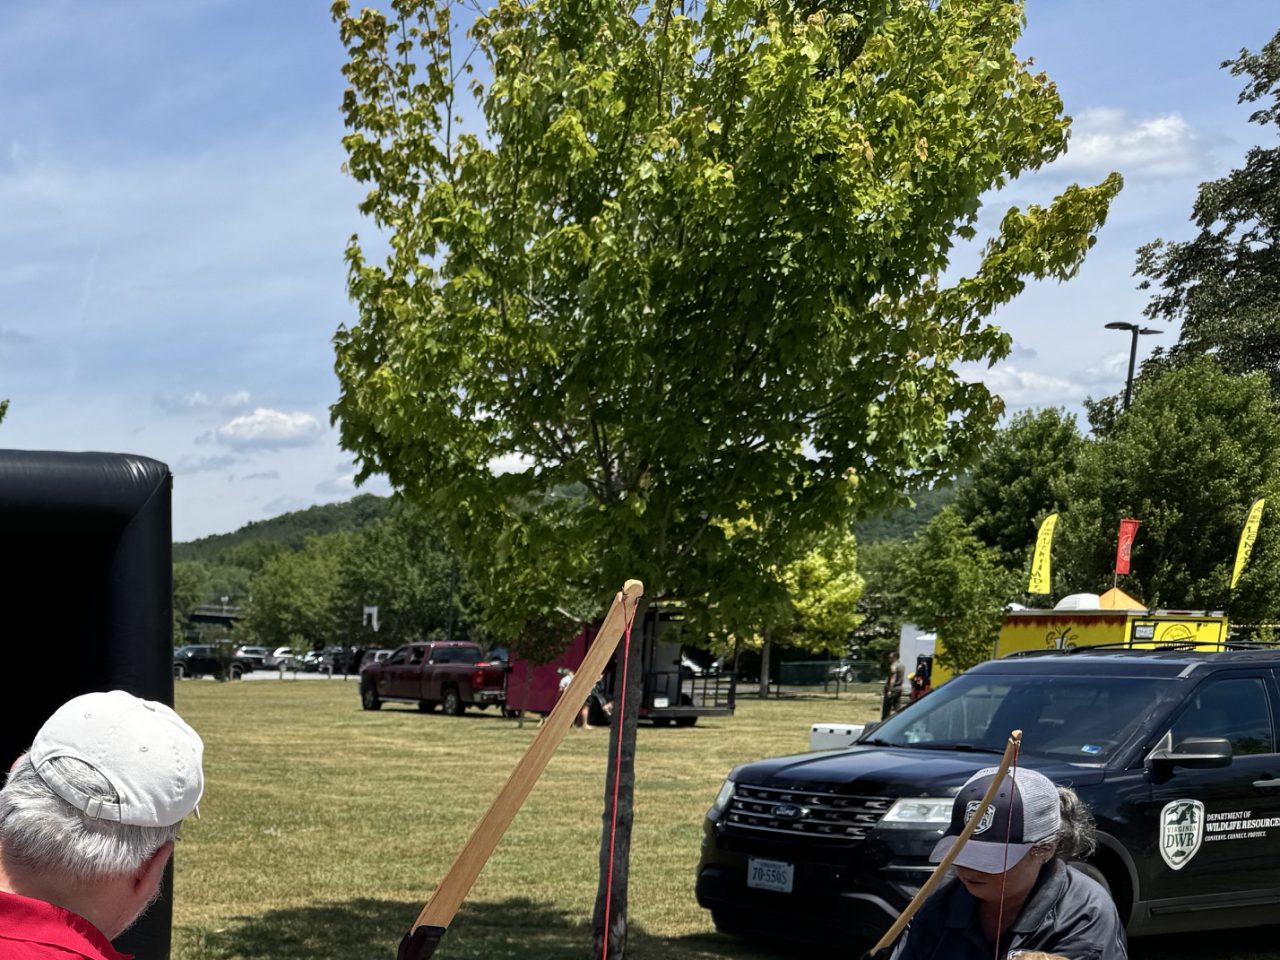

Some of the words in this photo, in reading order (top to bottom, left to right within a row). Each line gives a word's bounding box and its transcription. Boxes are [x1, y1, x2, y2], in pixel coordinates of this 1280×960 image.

[776, 806, 796, 816] Ford
[1206, 811, 1243, 821] DEPARTMENT
[1243, 811, 1252, 819] OF
[1167, 825, 1196, 833] VIRGINIA
[1206, 820, 1241, 832] WILDLIFE
[1166, 832, 1195, 848] DWR
